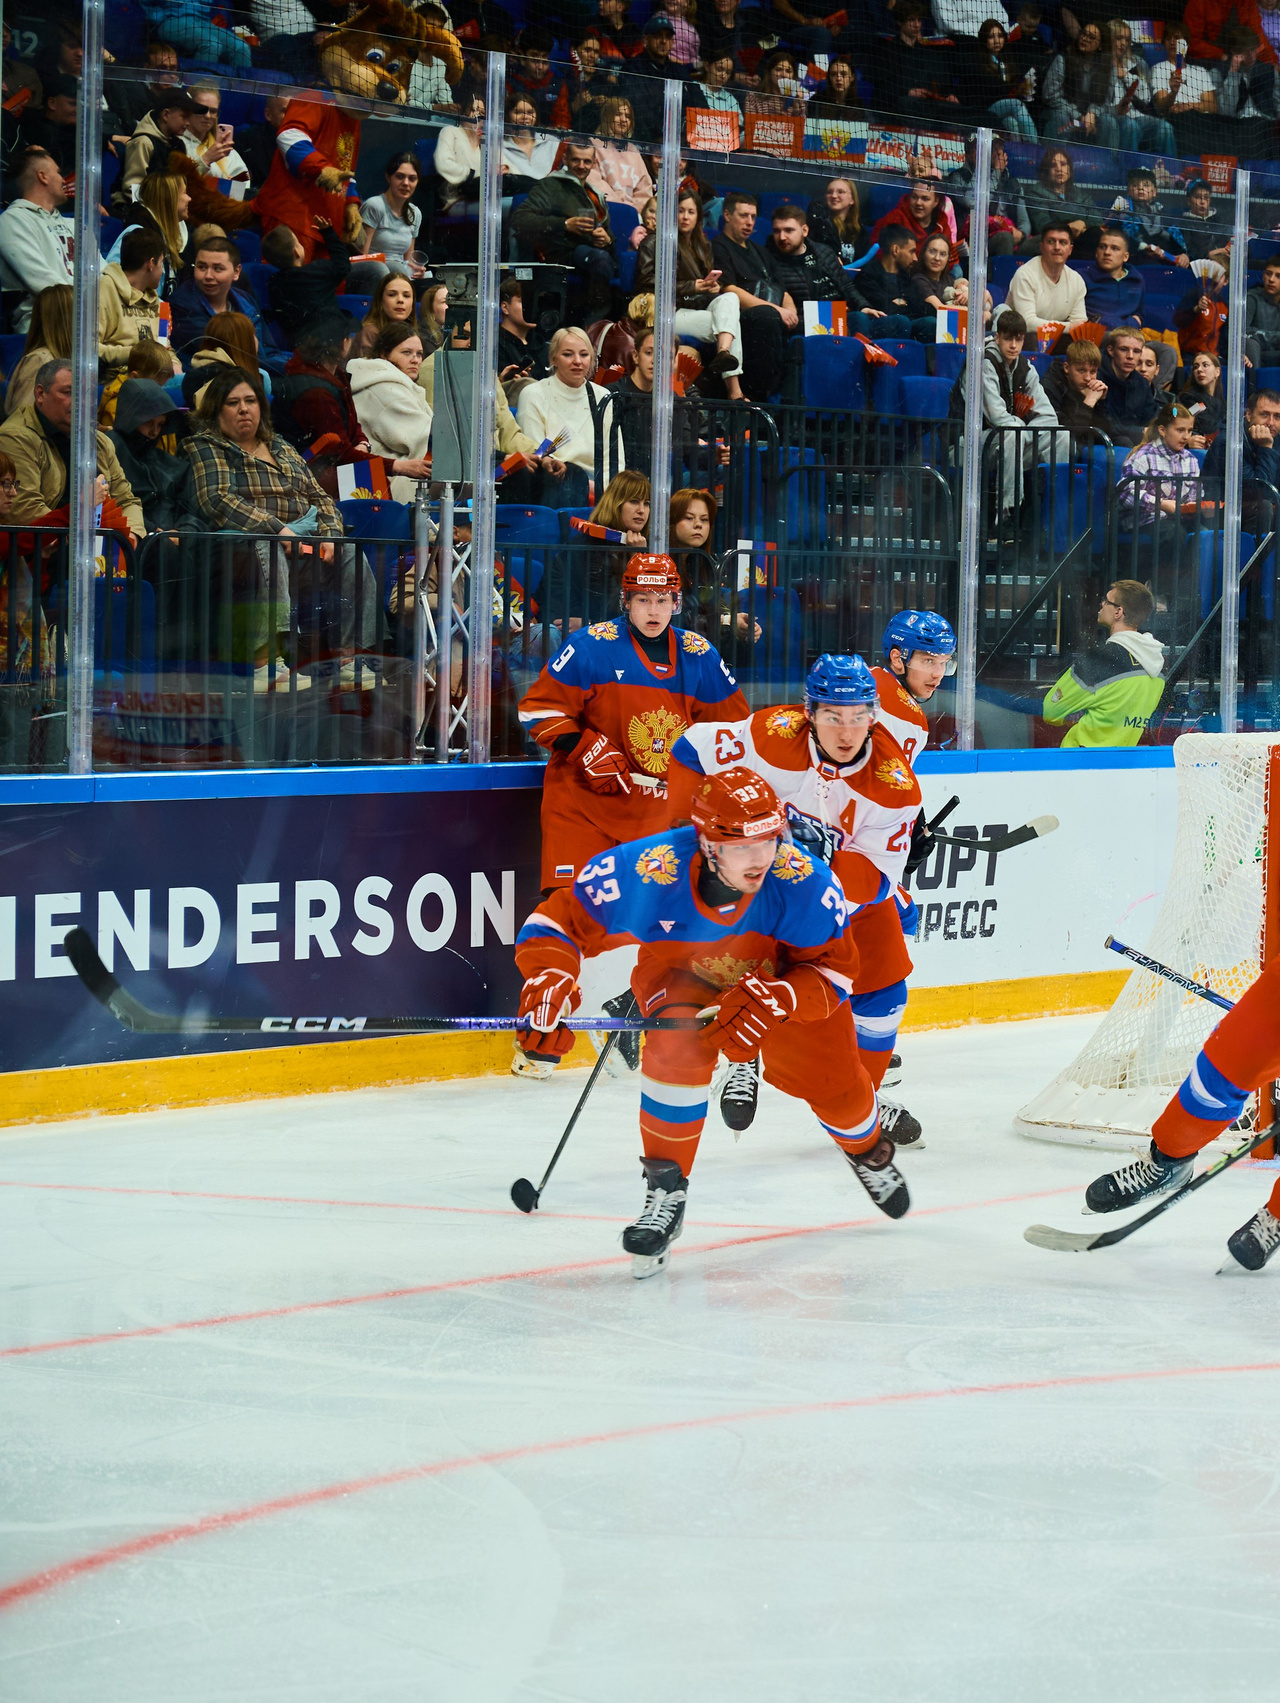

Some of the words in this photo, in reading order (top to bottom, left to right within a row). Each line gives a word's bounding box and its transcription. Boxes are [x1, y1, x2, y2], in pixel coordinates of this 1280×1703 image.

[637, 576, 667, 584] РОЛЬФ
[891, 634, 904, 642] CCM
[551, 643, 576, 673] 9
[583, 734, 609, 766] BAU
[715, 728, 746, 766] 23
[733, 785, 760, 803] 33
[745, 816, 781, 835] РОЛЬФ
[839, 798, 857, 836] A
[902, 824, 1009, 891] ОРТ
[577, 855, 621, 906] 33
[1123, 948, 1207, 994] SHADOW
[260, 1016, 367, 1033] CCM
